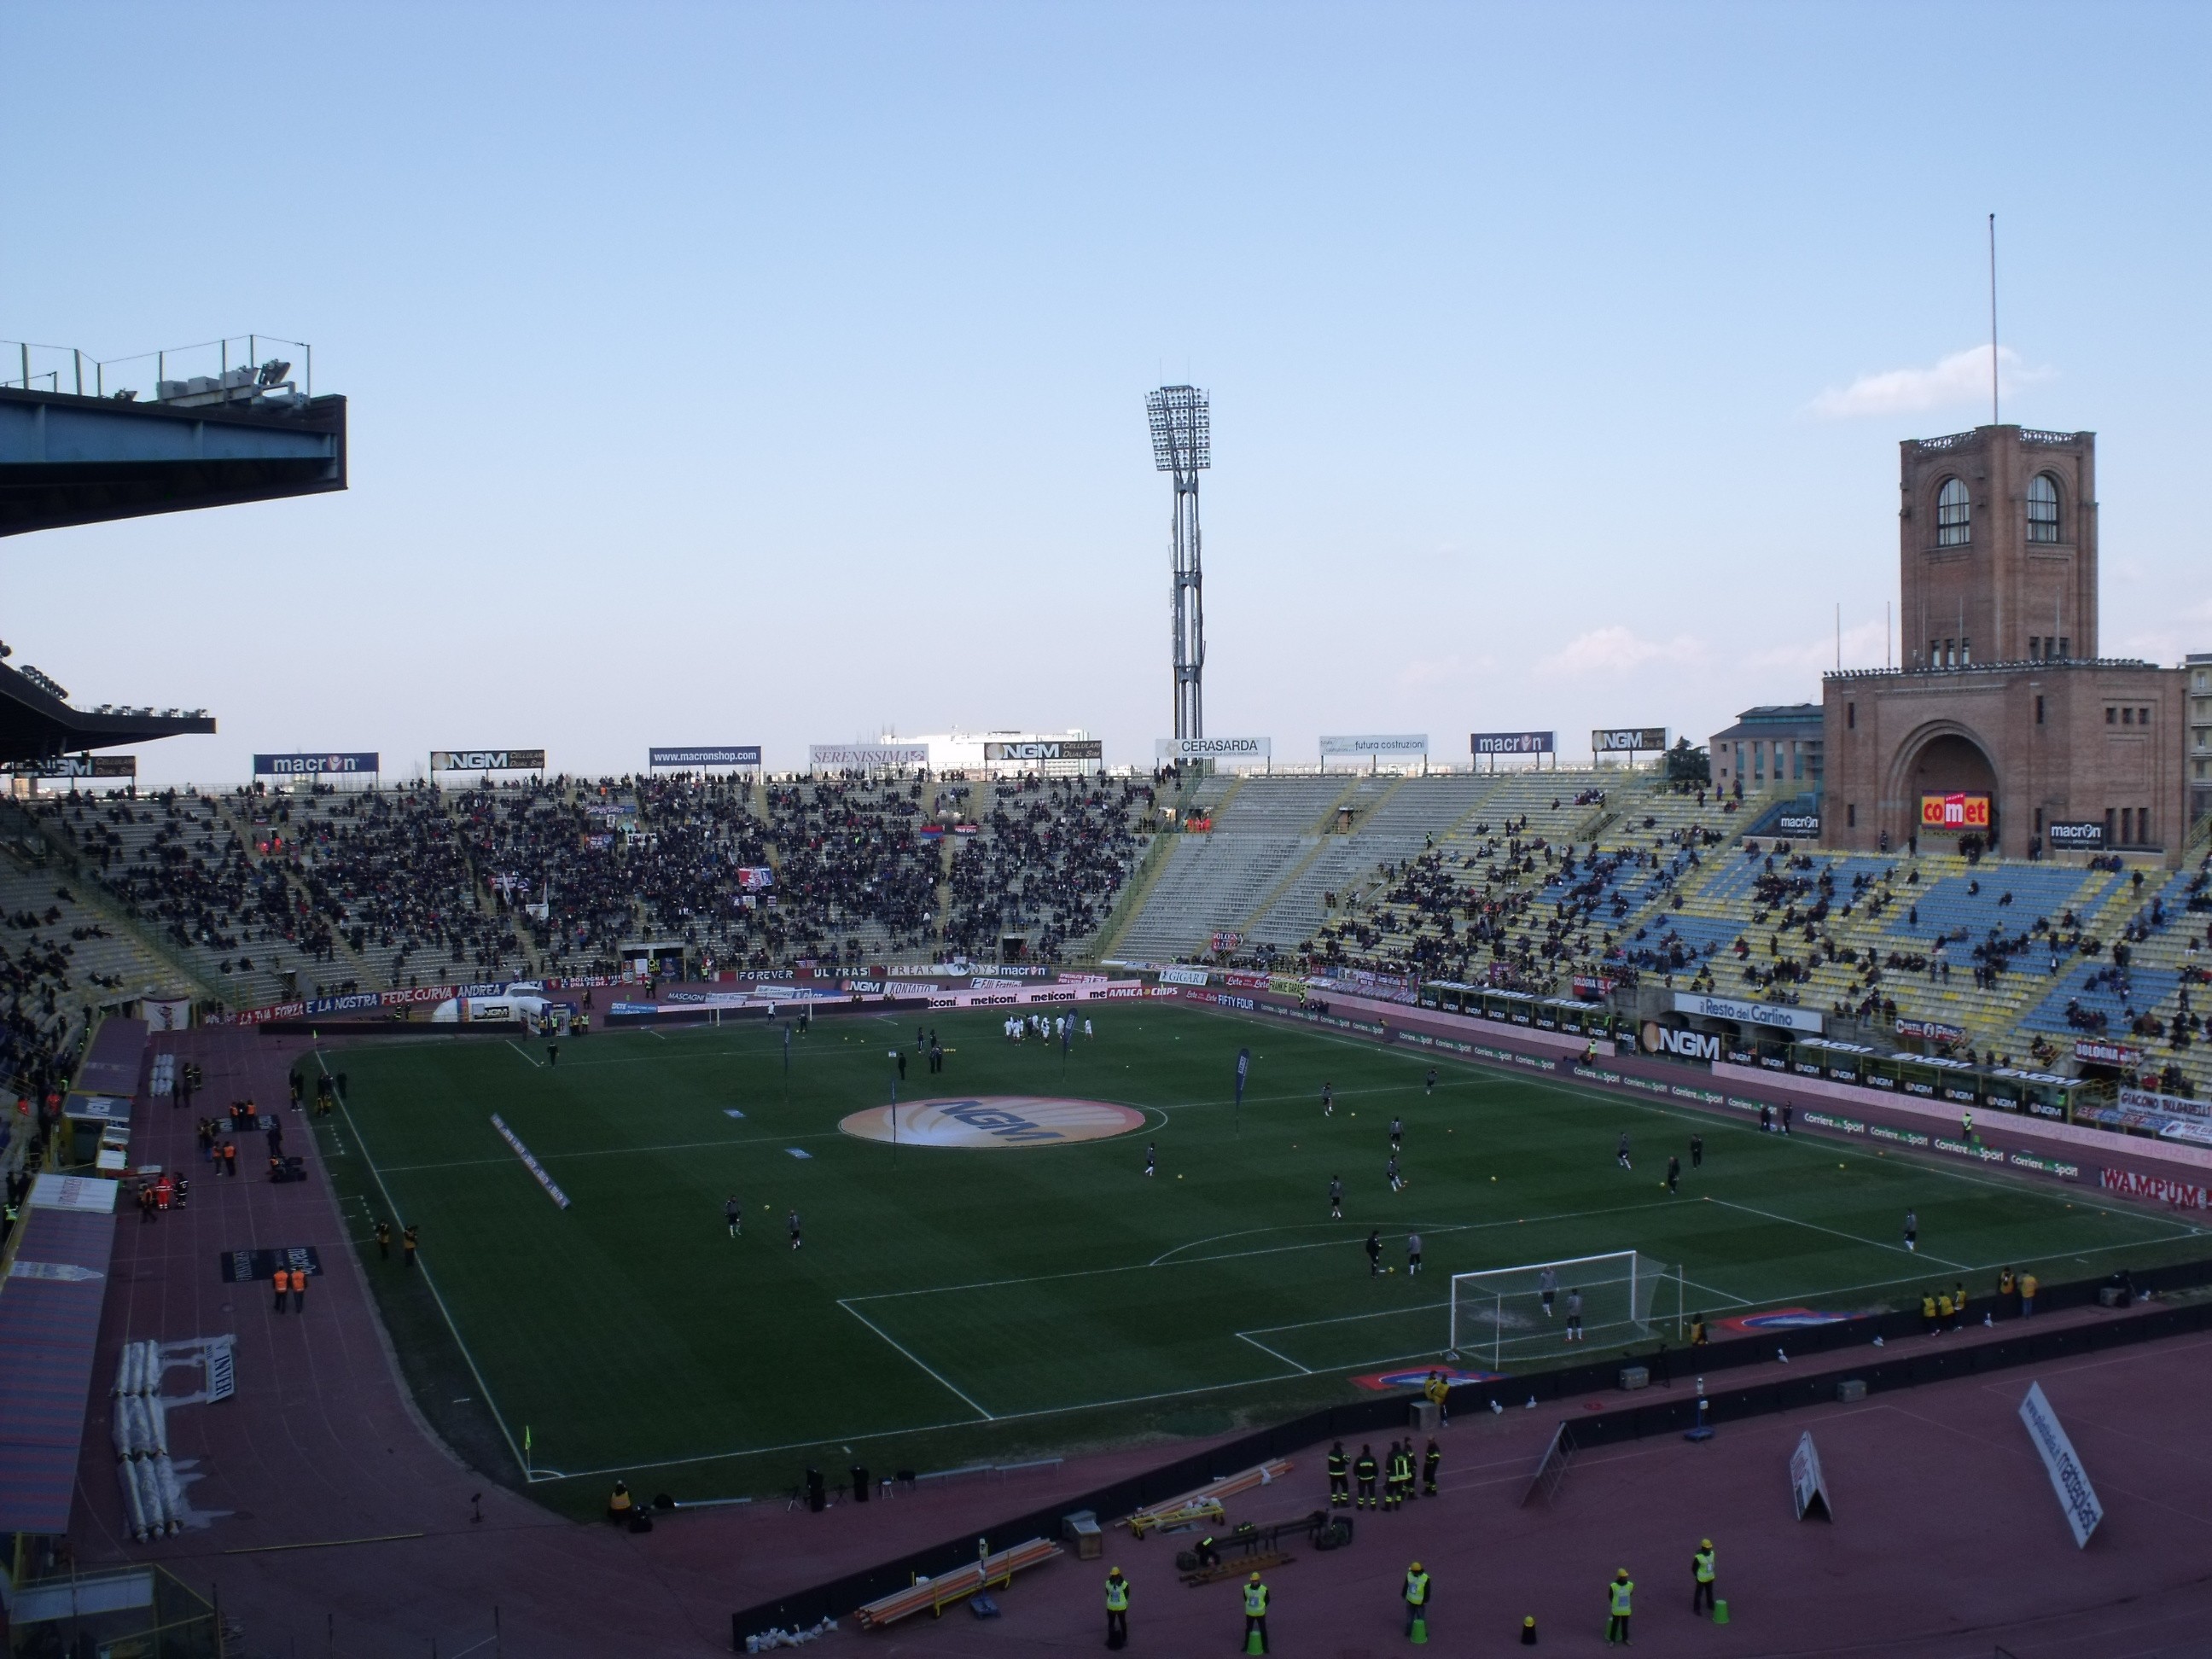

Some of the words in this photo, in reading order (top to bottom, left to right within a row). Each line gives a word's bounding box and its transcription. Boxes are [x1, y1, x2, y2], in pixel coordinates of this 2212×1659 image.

[1181, 740, 1258, 751] CERASARDA
[1355, 741, 1379, 751] futura
[1381, 739, 1424, 748] costruzioni
[1480, 735, 1541, 752] macron
[1604, 732, 1642, 748] NGM
[654, 750, 757, 762] www.macronshop.com
[813, 750, 911, 763] SERENISSIMA
[1003, 743, 1059, 759] NGM
[274, 754, 356, 772] macron
[449, 754, 508, 768] NGM
[1924, 801, 1985, 822] comet
[1781, 815, 1819, 828] macron
[2052, 824, 2101, 838] macron
[740, 970, 794, 981] FOREVER
[890, 966, 934, 975] FREAK
[1001, 966, 1045, 975] macron
[1169, 972, 1208, 984] GIGART
[1226, 976, 1243, 986] Lete
[1254, 979, 1270, 989] Lete
[849, 981, 881, 992] NGM
[890, 983, 931, 994] KONTATTO
[1109, 988, 1143, 997] AMICA
[1151, 987, 1179, 996] CHIPS
[1270, 980, 1289, 992] FRANKIE
[275, 1004, 304, 1018] FORZA
[317, 999, 332, 1012] LA
[335, 994, 378, 1010] NOSTRA
[457, 984, 501, 998] ANDREA
[668, 992, 706, 1002] MASCAGNI
[971, 995, 1016, 1005] meliconi
[1031, 990, 1077, 1001] meliconi
[1218, 994, 1237, 1007] FIFTY
[1237, 998, 1254, 1010] FOUR
[1700, 1001, 1705, 1013] il
[1706, 998, 1735, 1016] Resto
[1736, 1008, 1749, 1020] del
[1751, 1005, 1792, 1026] Carlino
[1399, 1032, 1416, 1042] Corriere
[1420, 1035, 1432, 1045] Sport
[1659, 1027, 1720, 1061] NGM
[1435, 1039, 1453, 1049] Corriere
[1458, 1043, 1471, 1053] Sport
[2076, 1044, 2118, 1060] BOLOGNA
[1475, 1046, 1493, 1057] Corriere
[1499, 1051, 1512, 1061] Sport
[1736, 1051, 1751, 1062] NGM
[1516, 1055, 1534, 1066] Corriere
[1541, 1059, 1555, 1070] Sport
[1768, 1058, 1785, 1068] NGM
[1915, 1055, 1973, 1068] NGM
[1802, 1063, 1819, 1074] NGM
[1837, 1070, 1855, 1080] NGM
[1574, 1067, 1596, 1079] Corriere
[1603, 1071, 1620, 1084] Sport
[1873, 1075, 1894, 1087] NGM
[2020, 1070, 2082, 1086] NGM
[1624, 1077, 1645, 1088] Corriere
[1652, 1081, 1668, 1092] Sport
[1912, 1082, 1933, 1094] NGM
[1672, 1086, 1697, 1099] Corriere
[1705, 1091, 1723, 1105] Sport
[1951, 1089, 1974, 1102] NGM
[1728, 1097, 1752, 1110] Corriere
[1994, 1096, 2017, 1109] NGM
[2036, 1103, 2062, 1116] NGM
[925, 1100, 1066, 1142] NGM
[1804, 1113, 1834, 1126] Corriere
[1843, 1120, 1864, 1133] Sport
[1985, 1112, 2118, 1145] stiledibologna.com
[1870, 1126, 1899, 1140] Corriere
[1908, 1132, 1928, 1145] Sport
[1934, 1138, 1968, 1155] Corriere
[1979, 1146, 2004, 1162] Sport
[2133, 1139, 2195, 1161] agenzia
[2011, 1155, 2043, 1170] Corriere
[2054, 1161, 2079, 1178] Sport
[2103, 1167, 2200, 1210] WAMPUM
[214, 1354, 232, 1395] INVER
[2057, 1452, 2098, 1536] matteplast
